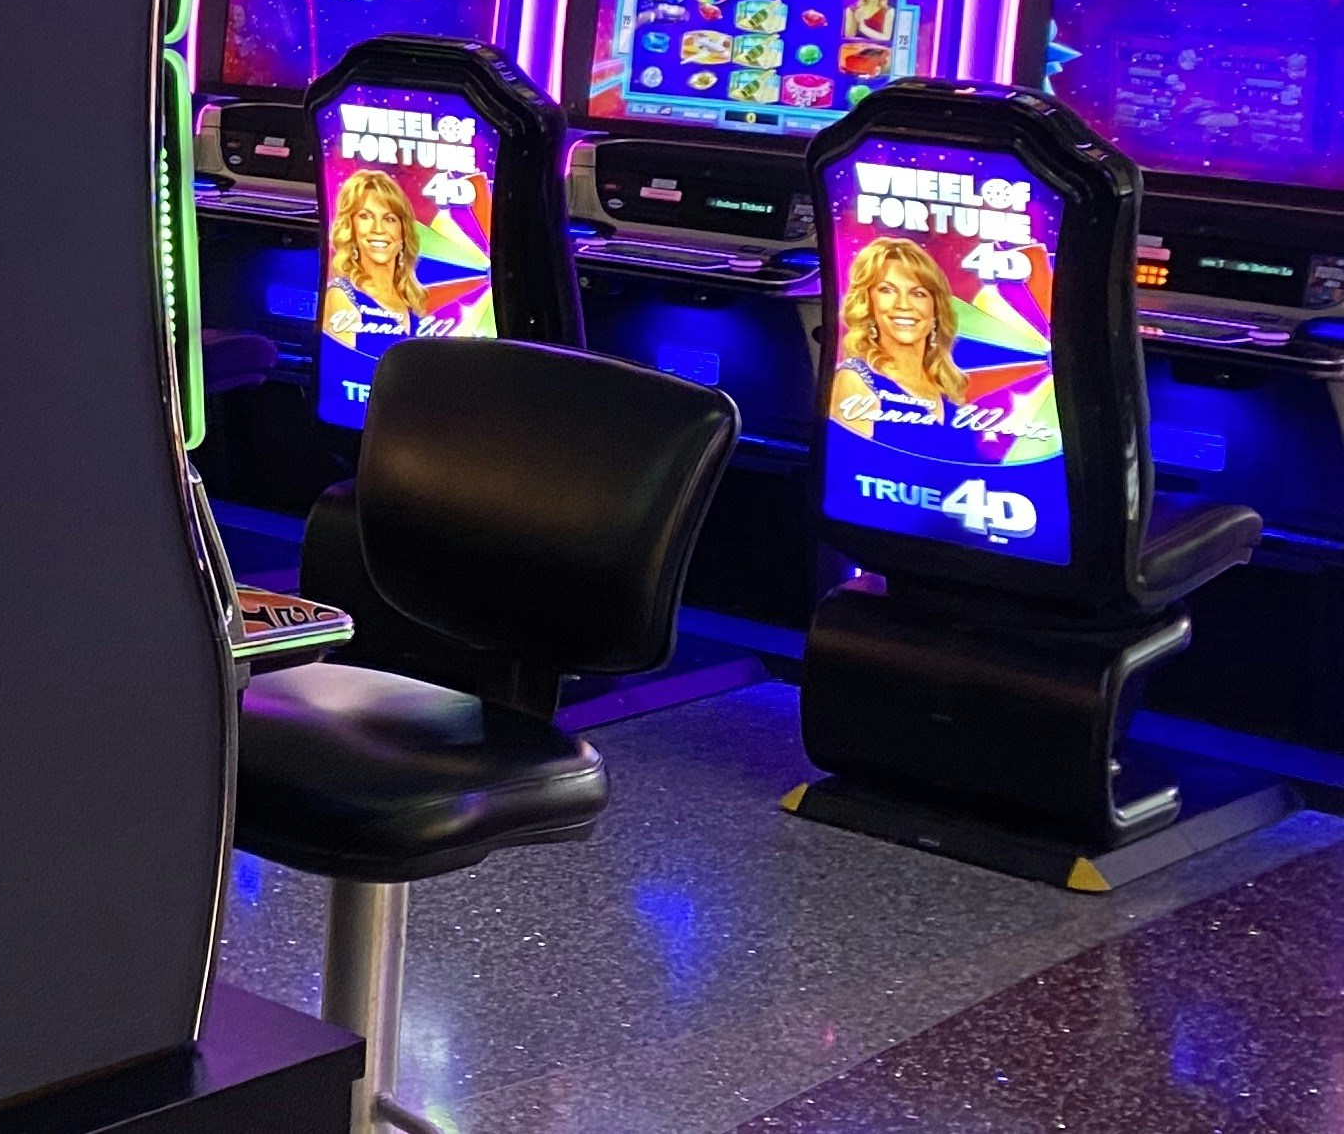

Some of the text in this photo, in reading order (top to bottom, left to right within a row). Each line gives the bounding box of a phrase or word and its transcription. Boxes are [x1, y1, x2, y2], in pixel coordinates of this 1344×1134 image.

[339, 103, 440, 142] WHEEL
[340, 132, 477, 175] FORTUNE
[422, 171, 477, 207] 4D
[854, 162, 984, 207] WHEEL
[856, 194, 1032, 246] FORTUNE
[960, 241, 1033, 285] 4D
[839, 394, 936, 426] Vanna
[854, 473, 1037, 540] TRUE 4D
